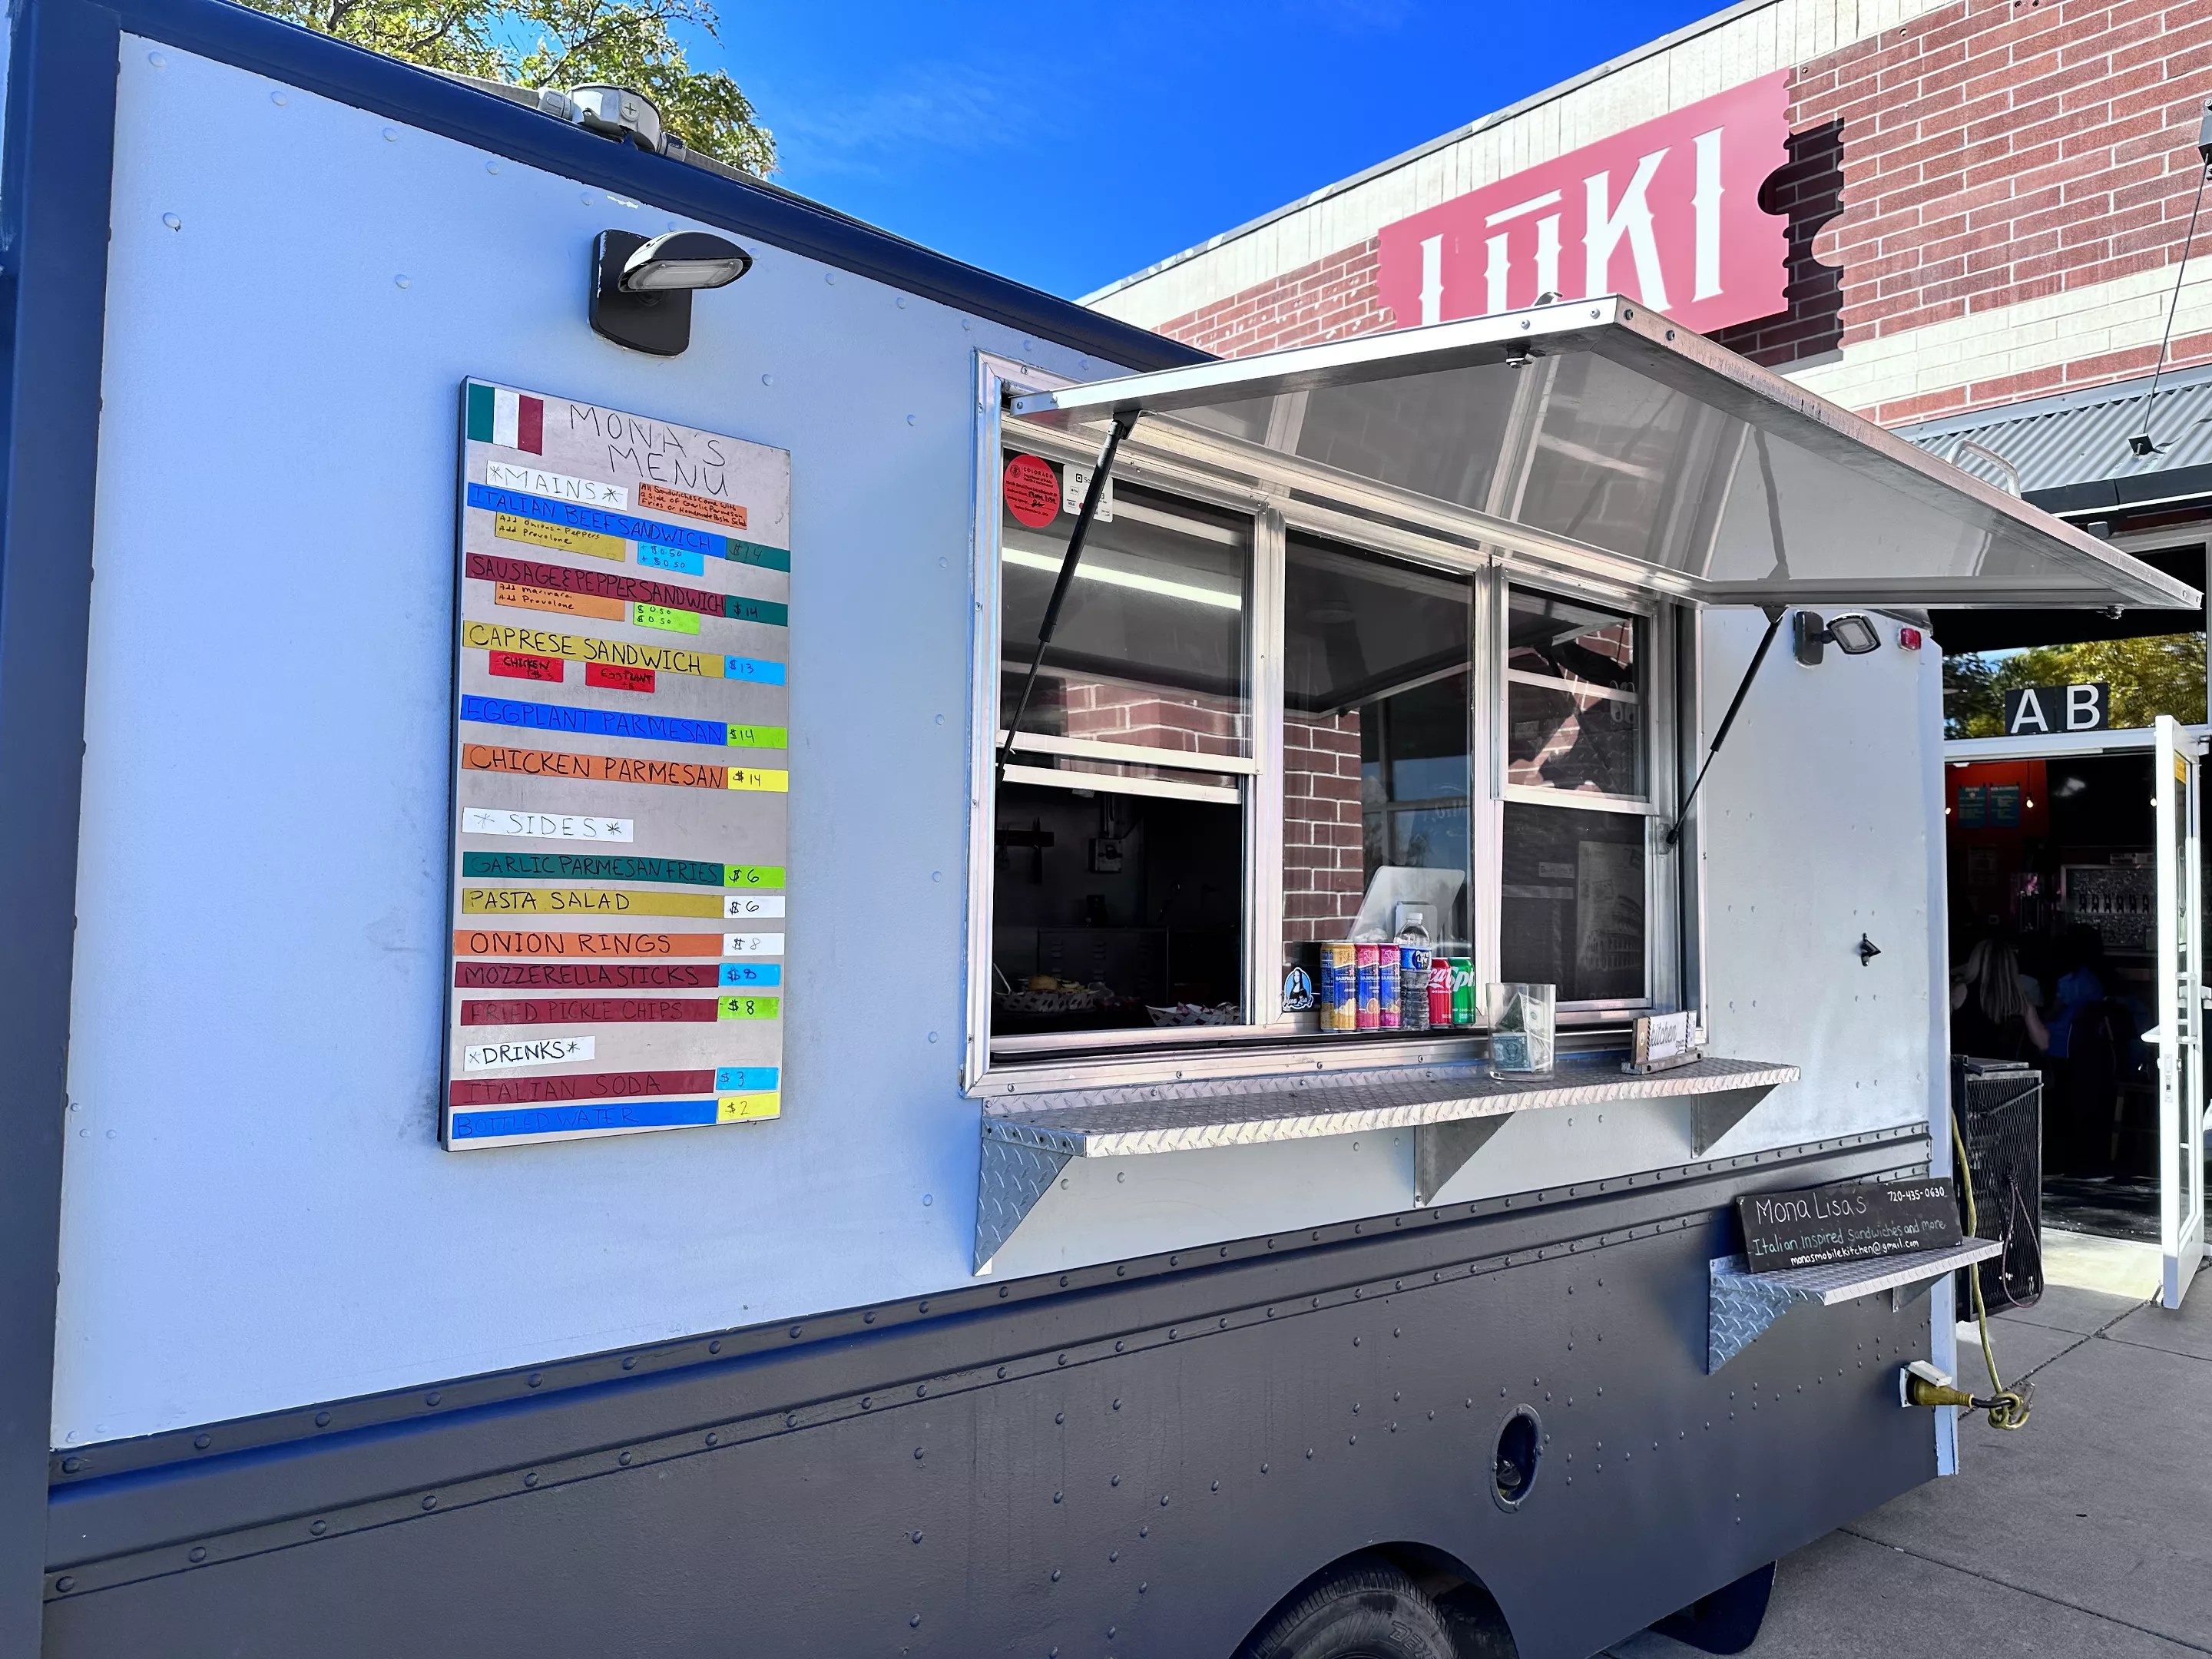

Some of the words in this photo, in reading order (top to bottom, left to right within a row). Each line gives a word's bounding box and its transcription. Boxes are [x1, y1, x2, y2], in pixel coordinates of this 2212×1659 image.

[570, 403, 727, 467] MONA'S
[608, 445, 729, 497] MENU
[1023, 467, 1053, 478] COLORADO
[641, 483, 651, 492] All
[472, 485, 556, 518] ITALIAN
[566, 502, 614, 533] BEEF
[618, 516, 711, 552] SANDWICH
[499, 515, 518, 523] Add
[523, 528, 573, 545] Provolone
[471, 557, 561, 588] SAUSAGE
[576, 569, 637, 599] PEPPER
[639, 581, 725, 614] SANDWICH
[522, 594, 575, 611] Provolone
[469, 624, 577, 655] CAPRESE
[584, 638, 700, 676] SANDWICH
[465, 699, 589, 731] EGGPLANT
[602, 714, 723, 743] PARMESAN
[2010, 689, 2048, 733] A
[2066, 684, 2101, 730] B
[470, 746, 590, 778] CHICKEN
[604, 759, 724, 788] PARMESAN
[471, 856, 555, 875] GARLIC
[560, 856, 661, 879] PARMESAN
[667, 861, 718, 883] FRIES
[470, 891, 537, 910] PASTA
[551, 892, 630, 910] SALAD
[470, 932, 565, 955] ONION
[578, 933, 671, 954] RINGS
[465, 965, 612, 985] MOZZERELLA
[617, 965, 700, 986] STICKS
[470, 1001, 538, 1022] FRIED
[548, 999, 613, 1020] PICKLE
[621, 998, 684, 1019] CHIPS
[465, 1078, 577, 1103] ITALIAN
[589, 1075, 662, 1096] SODA
[456, 1108, 551, 1137] BOTTLED
[558, 1106, 639, 1126] WATER
[1887, 1186, 1945, 1202] 720-435-0630
[1755, 1198, 1812, 1225] Mona
[1752, 1233, 1798, 1256] Italian
[1800, 1228, 1843, 1253] Inspired
[1847, 1223, 1903, 1242] Sandwiches
[1905, 1219, 1919, 1234] and
[1921, 1219, 1946, 1231] more
